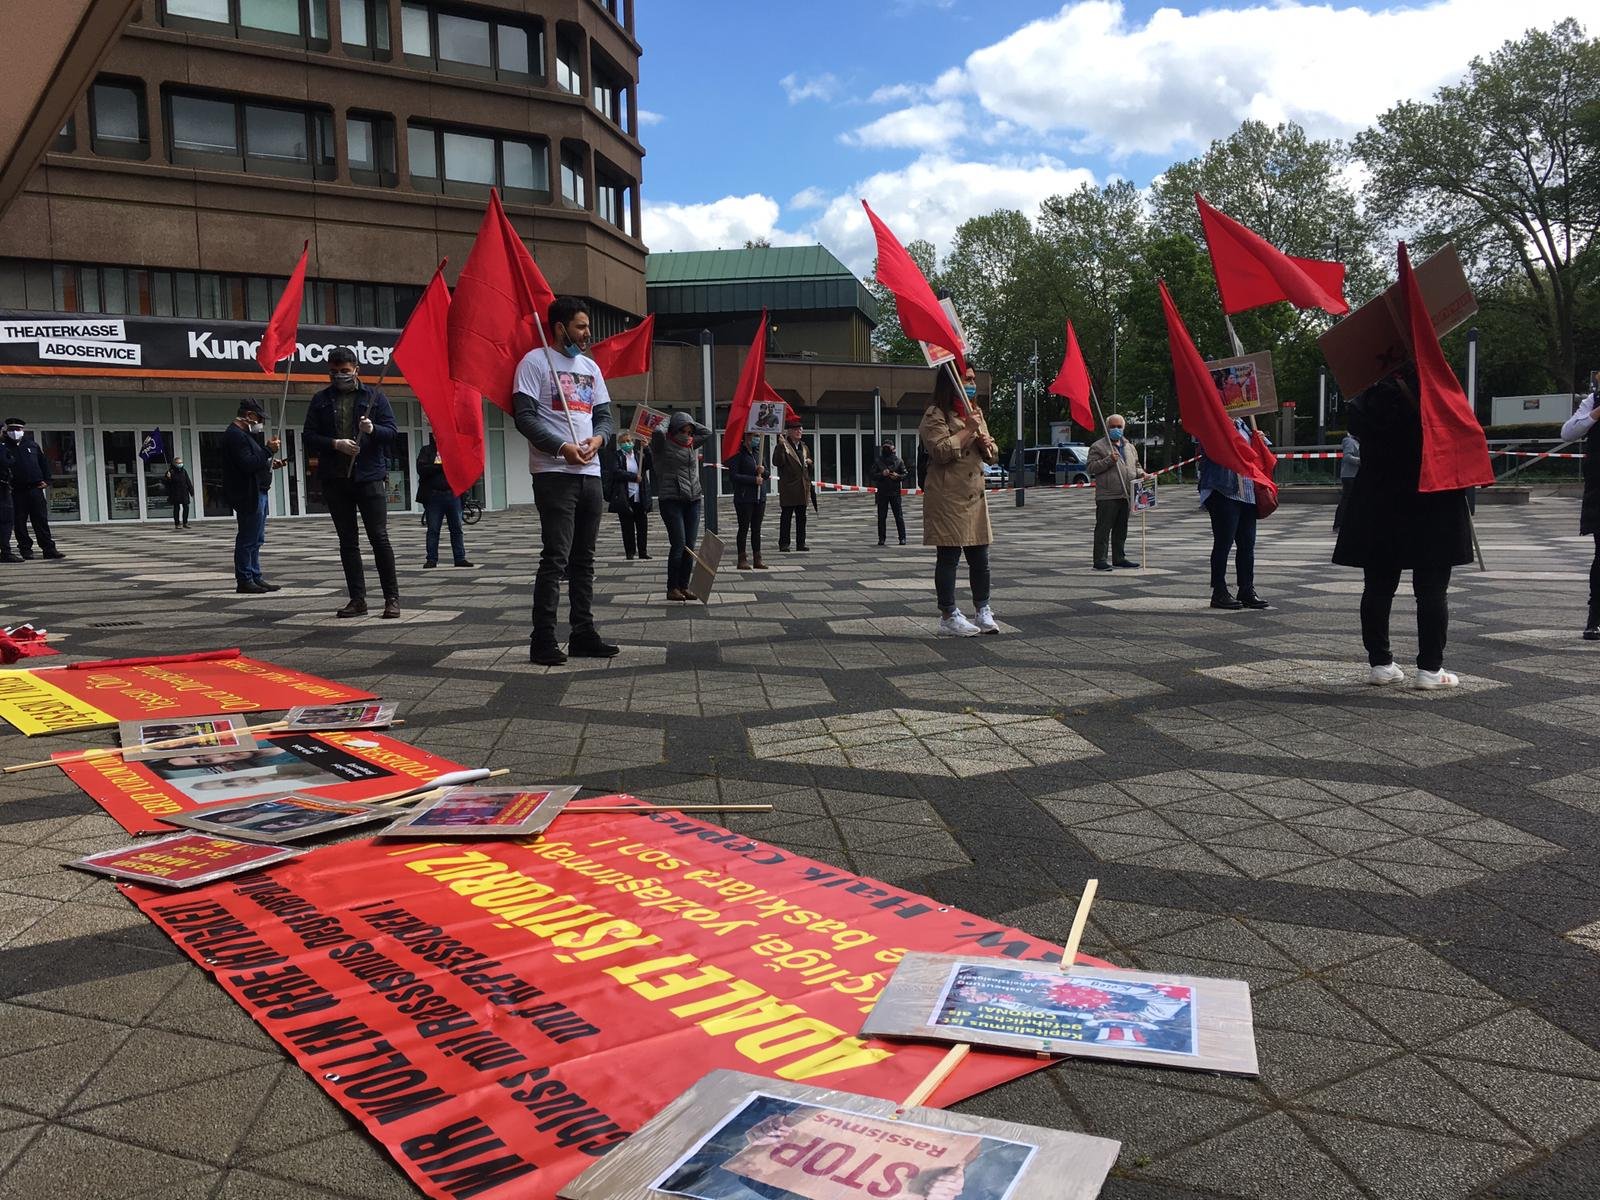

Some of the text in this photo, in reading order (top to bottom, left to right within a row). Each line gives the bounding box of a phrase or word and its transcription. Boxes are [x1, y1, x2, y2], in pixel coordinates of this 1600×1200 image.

[4, 325, 119, 338] THEATERKASSE
[45, 343, 136, 360] ABOSERVICE
[617, 843, 690, 870] son
[406, 851, 660, 963] İSTİYORUZ
[523, 836, 750, 934] yozlaştırmay
[805, 868, 933, 920] Halk
[362, 909, 541, 1005] REPRESSIONEN
[507, 1003, 600, 1044] und
[604, 955, 895, 1080] ADALET
[970, 1019, 1083, 1041] Kapitalismus
[978, 1005, 1057, 1020] CORONA!
[284, 1016, 456, 1125] WOLLEN
[436, 1031, 526, 1071] mit
[496, 1067, 632, 1156] chluss
[813, 1113, 948, 1158] Rassismus
[401, 1116, 538, 1200] WIR
[769, 1136, 920, 1199] STOP
